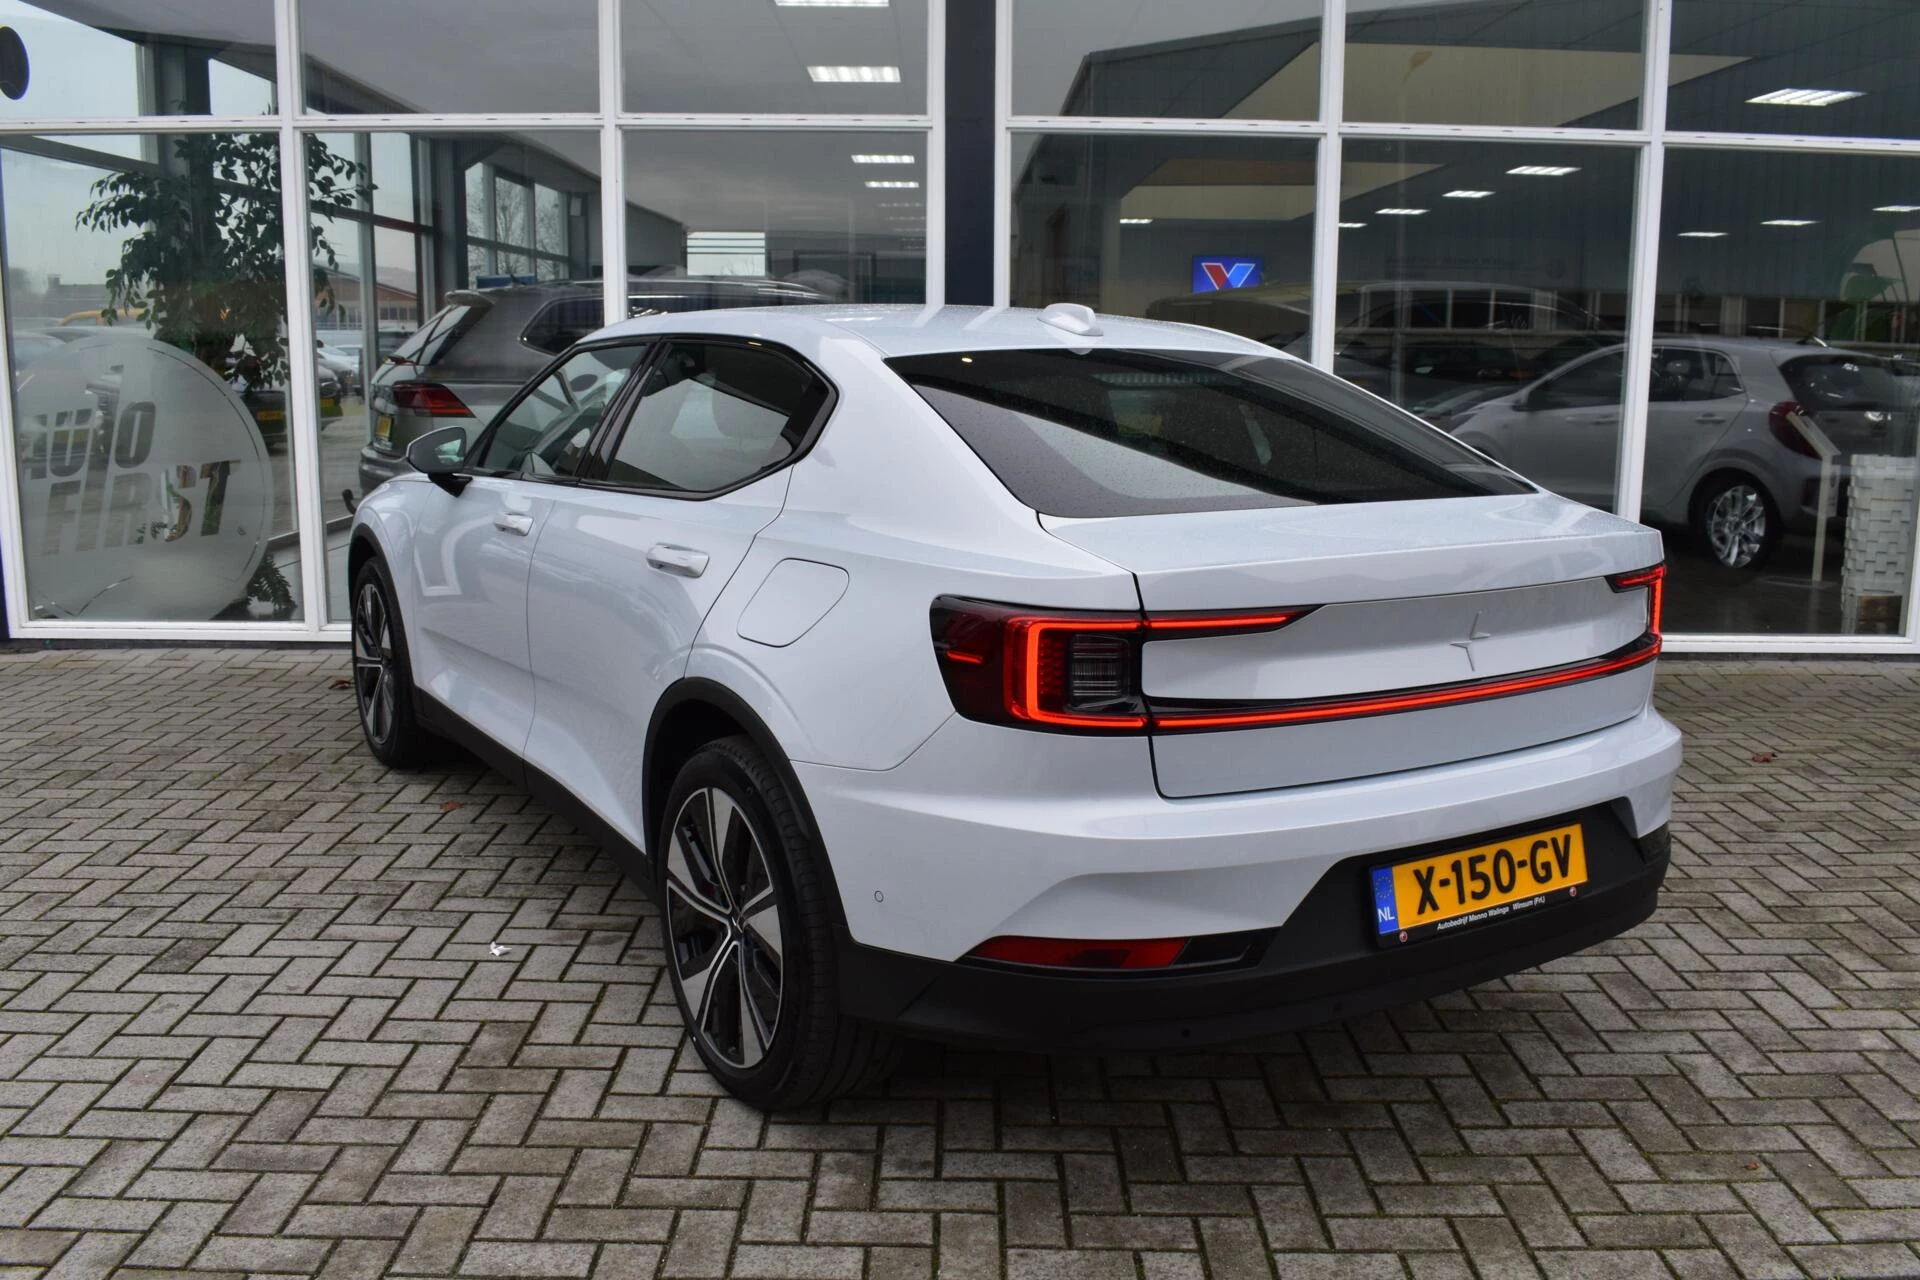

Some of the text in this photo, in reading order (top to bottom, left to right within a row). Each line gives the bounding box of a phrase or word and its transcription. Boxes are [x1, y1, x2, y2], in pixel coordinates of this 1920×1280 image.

[1413, 834, 1571, 915] X-150-GV
[1377, 905, 1396, 923] NL
[1437, 915, 1468, 930] Autobedrijf
